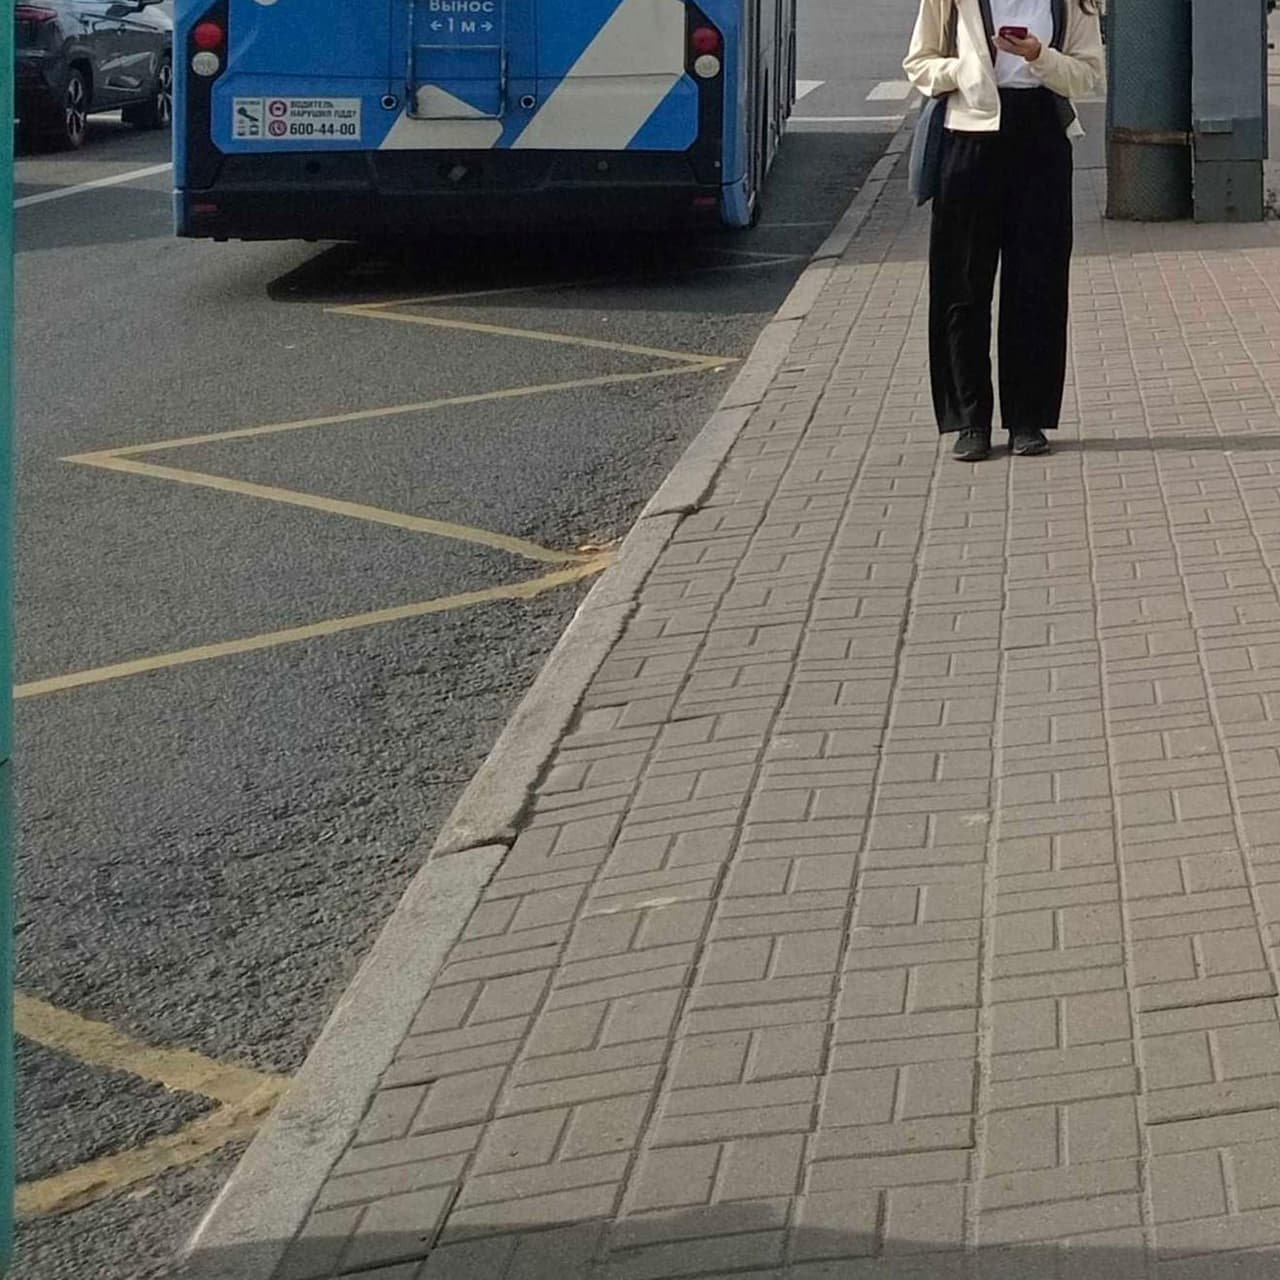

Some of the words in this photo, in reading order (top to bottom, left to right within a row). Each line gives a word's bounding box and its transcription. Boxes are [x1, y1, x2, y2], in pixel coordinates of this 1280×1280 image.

[447, 18, 454, 32] 1
[461, 21, 476, 32] м
[290, 123, 356, 135] 600-44-00
